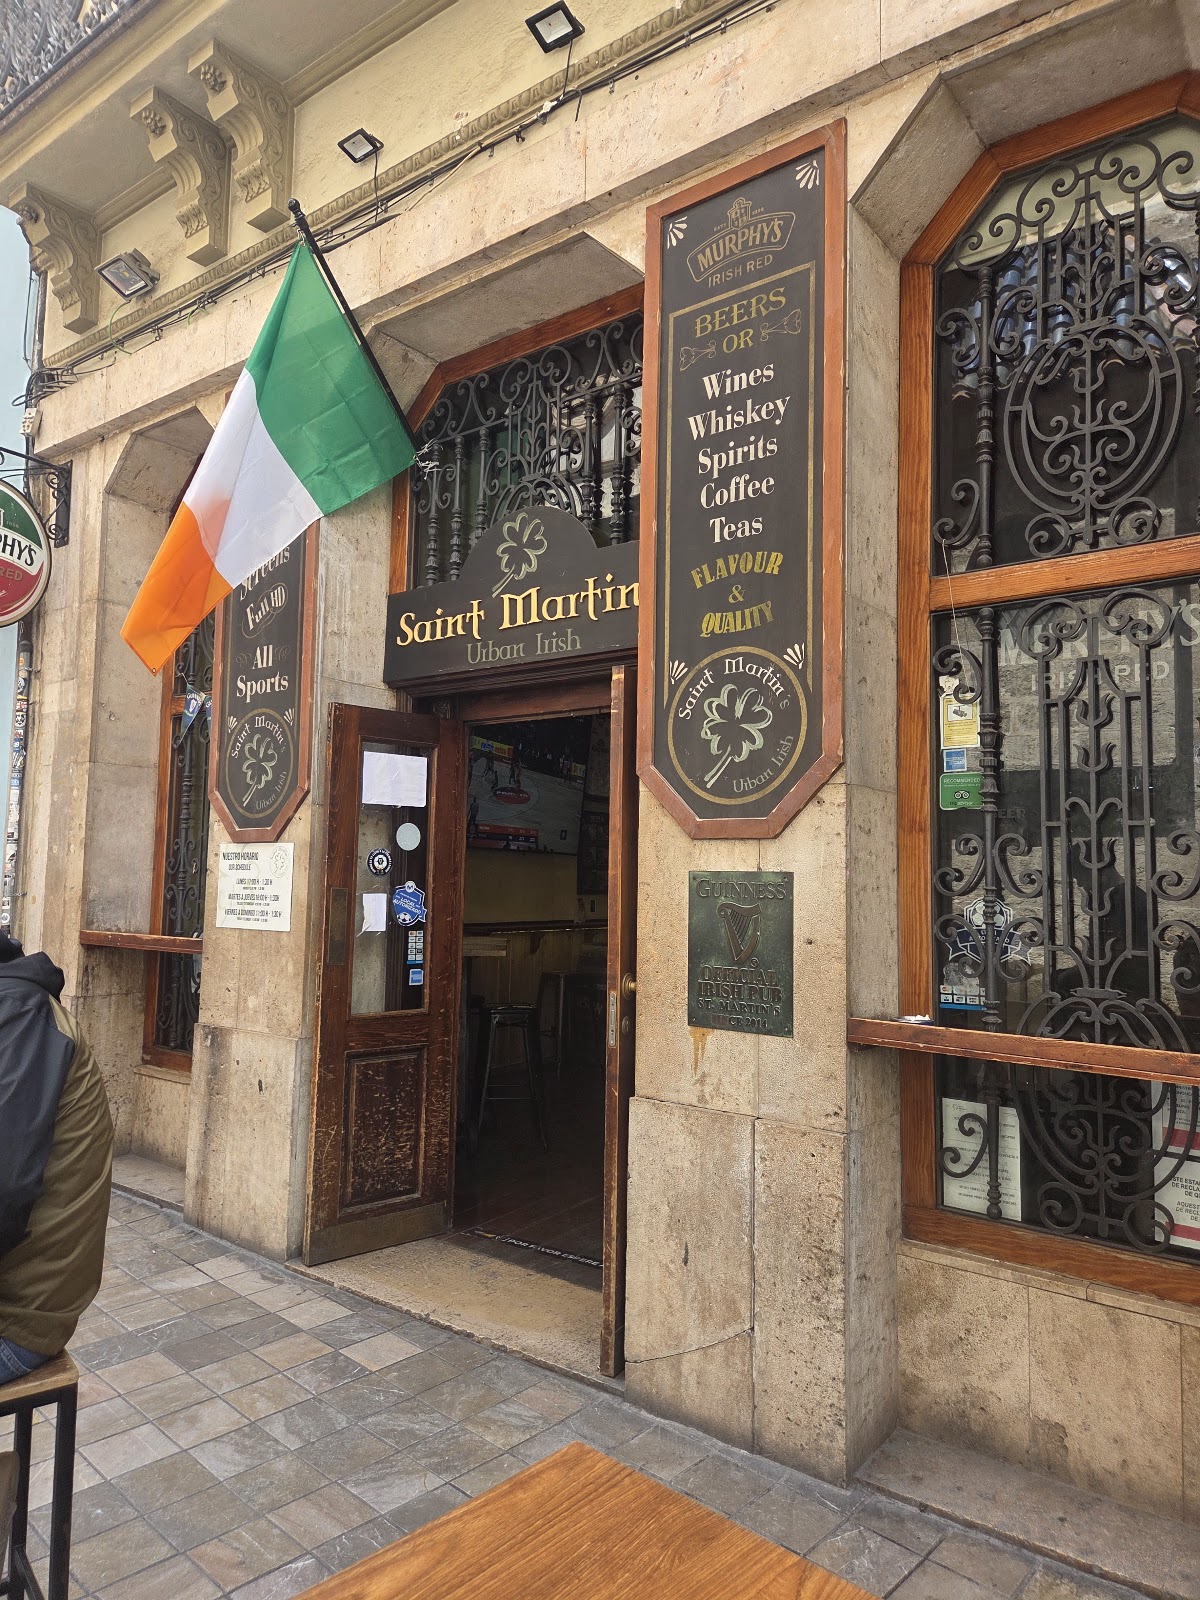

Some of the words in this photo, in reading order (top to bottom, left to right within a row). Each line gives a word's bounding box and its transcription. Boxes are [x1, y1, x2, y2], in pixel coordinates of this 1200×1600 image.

[696, 217, 785, 272] MURPHY'S
[708, 266, 743, 288] IRISH
[746, 254, 773, 273] RED
[694, 287, 787, 338] BEERS
[722, 328, 754, 354] OR
[702, 363, 775, 400] Wines
[687, 396, 791, 441] Whiskey
[698, 435, 778, 479] Spirits
[700, 475, 775, 509] Coffee
[709, 516, 763, 544] Teas
[0, 533, 37, 567] HY'S
[690, 551, 784, 590] FLAVOUR
[246, 597, 270, 631] Full
[270, 586, 286, 608] HD
[728, 584, 747, 604] &
[396, 599, 486, 646] Saint
[700, 601, 774, 638] QUALITY
[252, 645, 274, 670] All
[467, 641, 526, 664] Urban
[535, 629, 582, 655] Irish
[236, 674, 289, 703] Sports
[678, 668, 715, 720] Saint
[231, 722, 251, 759] Saint
[732, 767, 775, 794] Urban
[695, 878, 788, 900] GUINNESS
[698, 979, 745, 999] IRISH
[748, 983, 783, 1002] PUB
[701, 965, 777, 986] OFFICIAL
[719, 999, 781, 1016] MARTIN'S
[508, 1239, 529, 1247] POR
